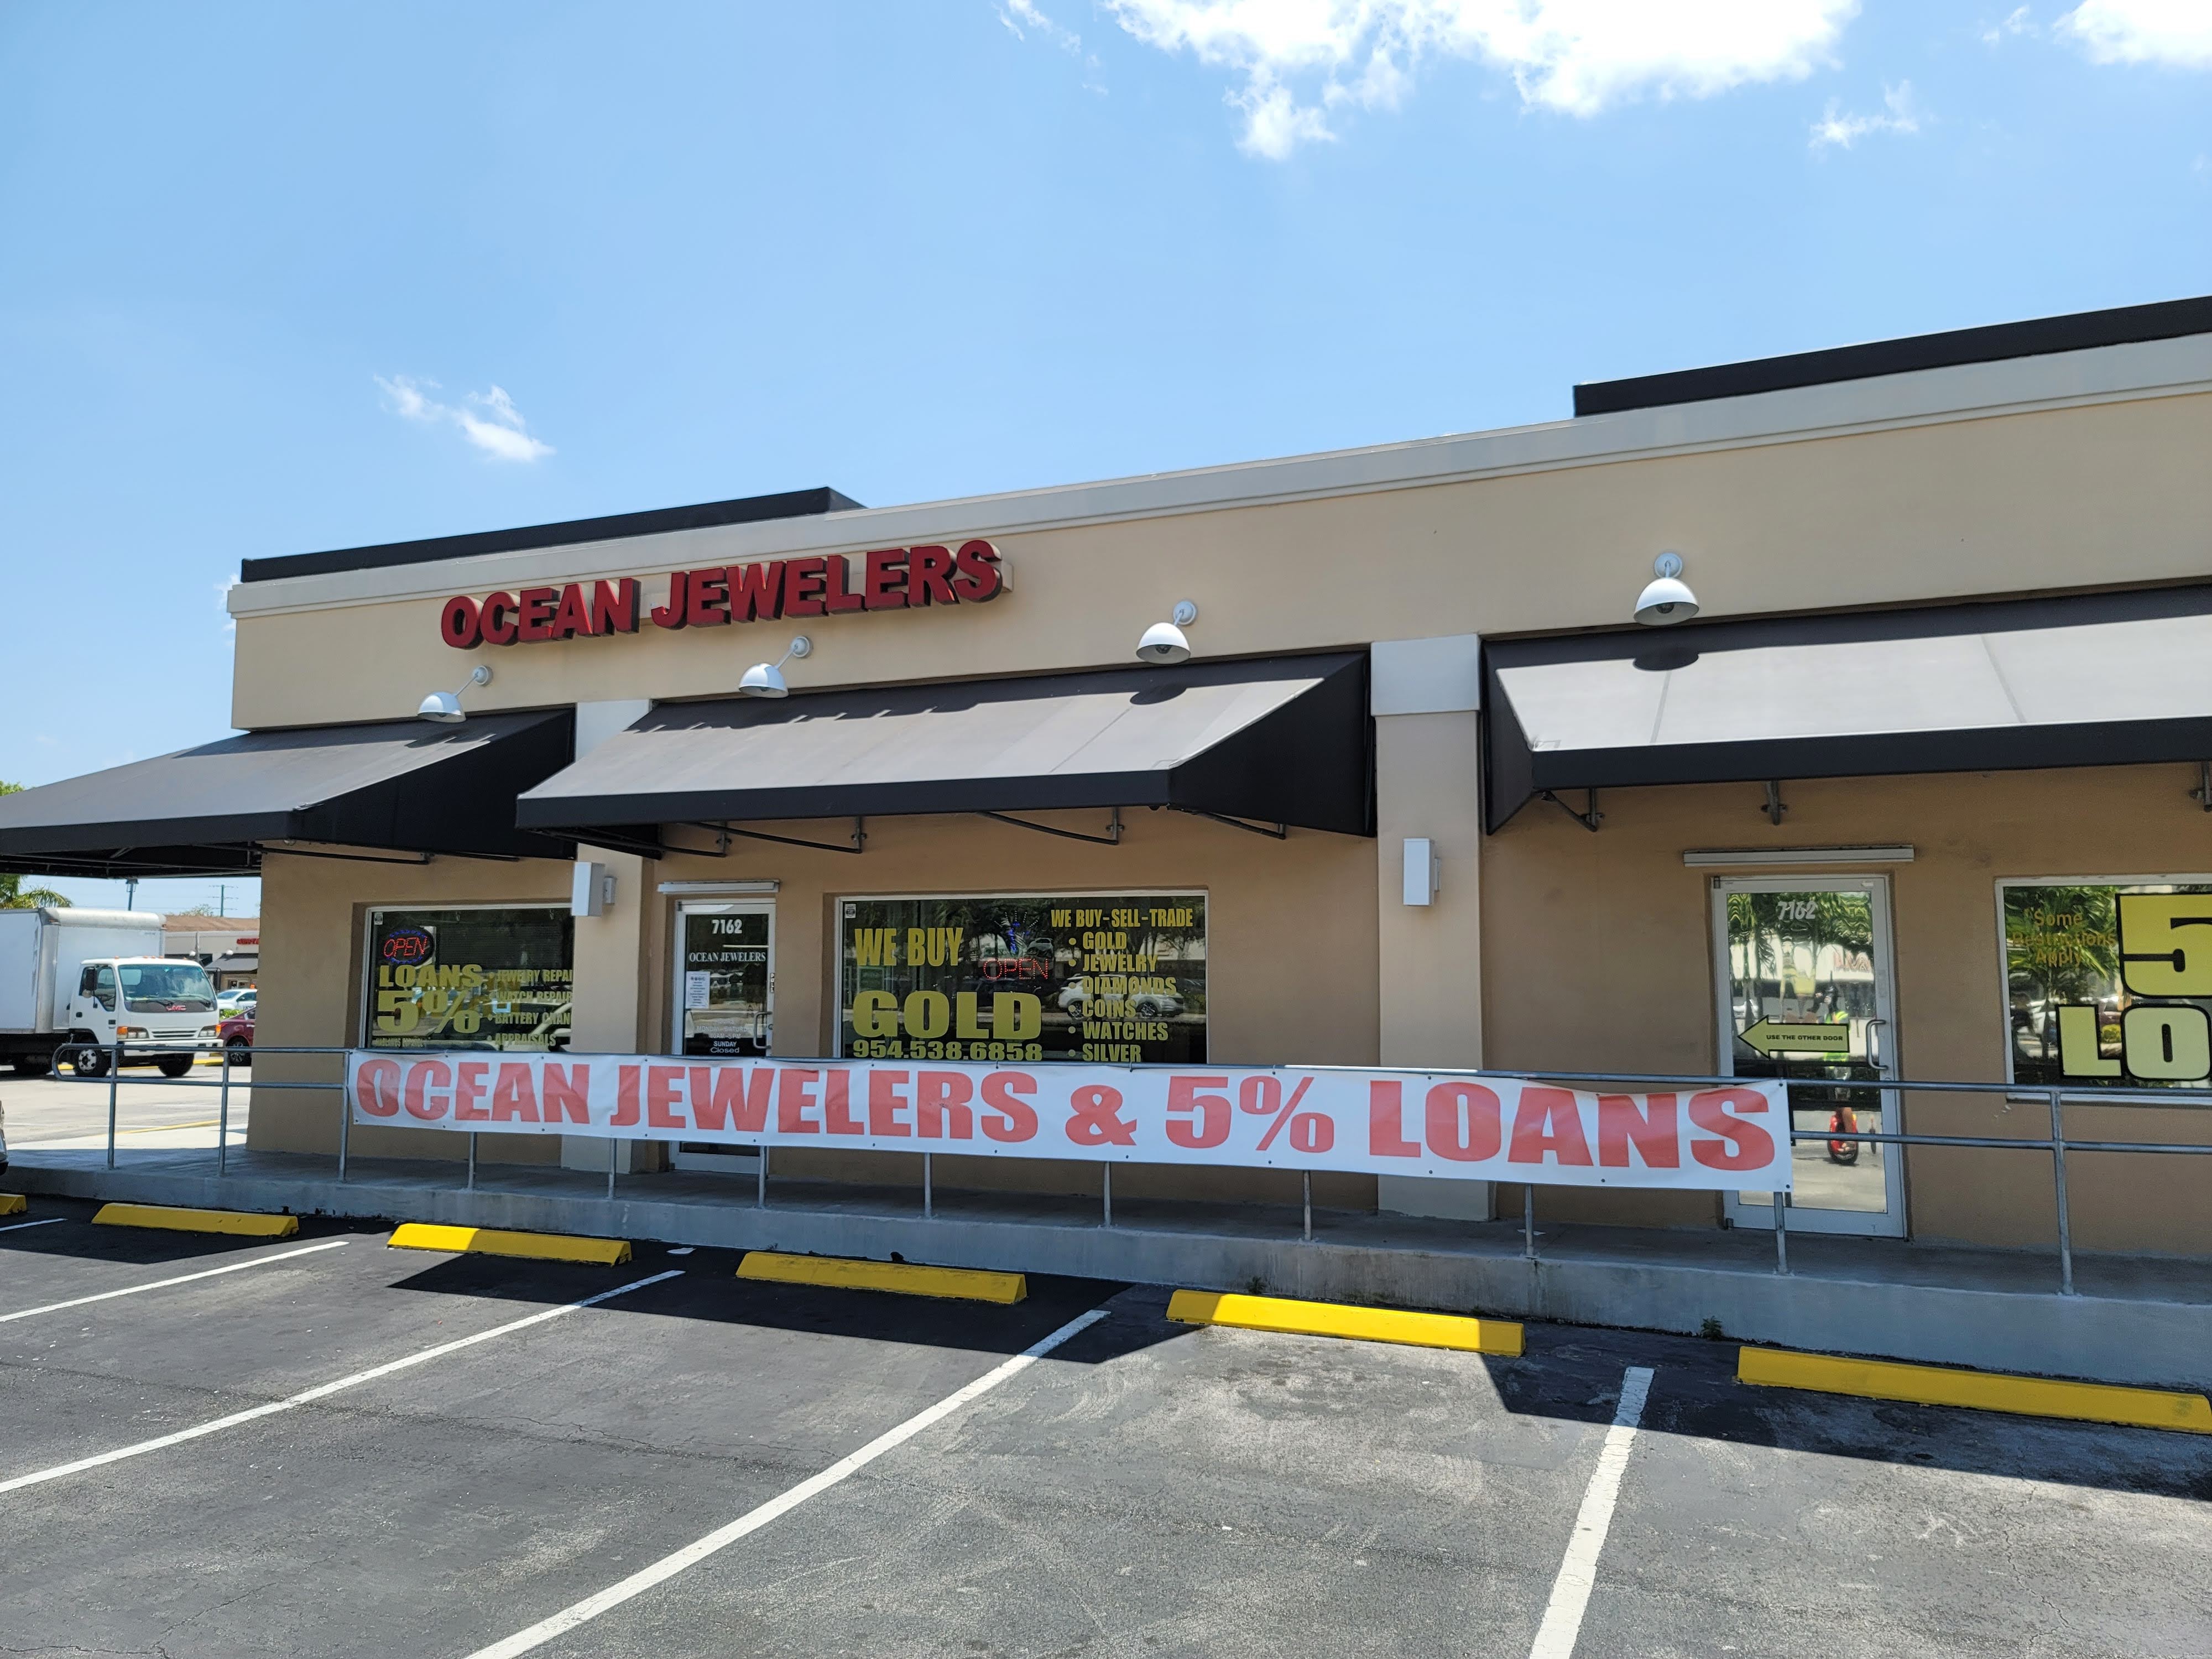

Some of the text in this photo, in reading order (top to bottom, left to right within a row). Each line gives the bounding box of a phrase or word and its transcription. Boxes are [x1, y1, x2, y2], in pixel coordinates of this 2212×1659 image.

[441, 539, 1004, 650] OCEAN JEWELERS
[1051, 910, 1071, 927] WE
[1777, 900, 1816, 920] 7162
[2034, 911, 2083, 927] Some
[711, 919, 742, 934] 7162
[383, 936, 427, 957] OPEN
[854, 927, 964, 966] WE BUY
[1082, 931, 1127, 950] GOLD
[2116, 894, 2212, 999] 5
[689, 952, 766, 962] OCEAN JEWELERS
[1082, 954, 1159, 972] JEWELRY
[2036, 947, 2081, 968] Apply
[379, 964, 483, 987] LOANS
[542, 969, 573, 982] REPAI
[983, 958, 1048, 980] OPEN
[1082, 976, 1177, 995] DIAMONDS
[377, 989, 481, 1034] 5%
[495, 1012, 539, 1024] BATTERY
[853, 990, 1041, 1040] GOLD
[1082, 999, 1136, 1018] COINS
[495, 1033, 556, 1046] APPRAISALS
[1082, 1021, 1168, 1041] WATCHES
[853, 1040, 1042, 1061] 954.538.6858
[1082, 1044, 1141, 1062] SILVER
[357, 1059, 1775, 1171] OCEAN JEWELERS & 5% LOANS
